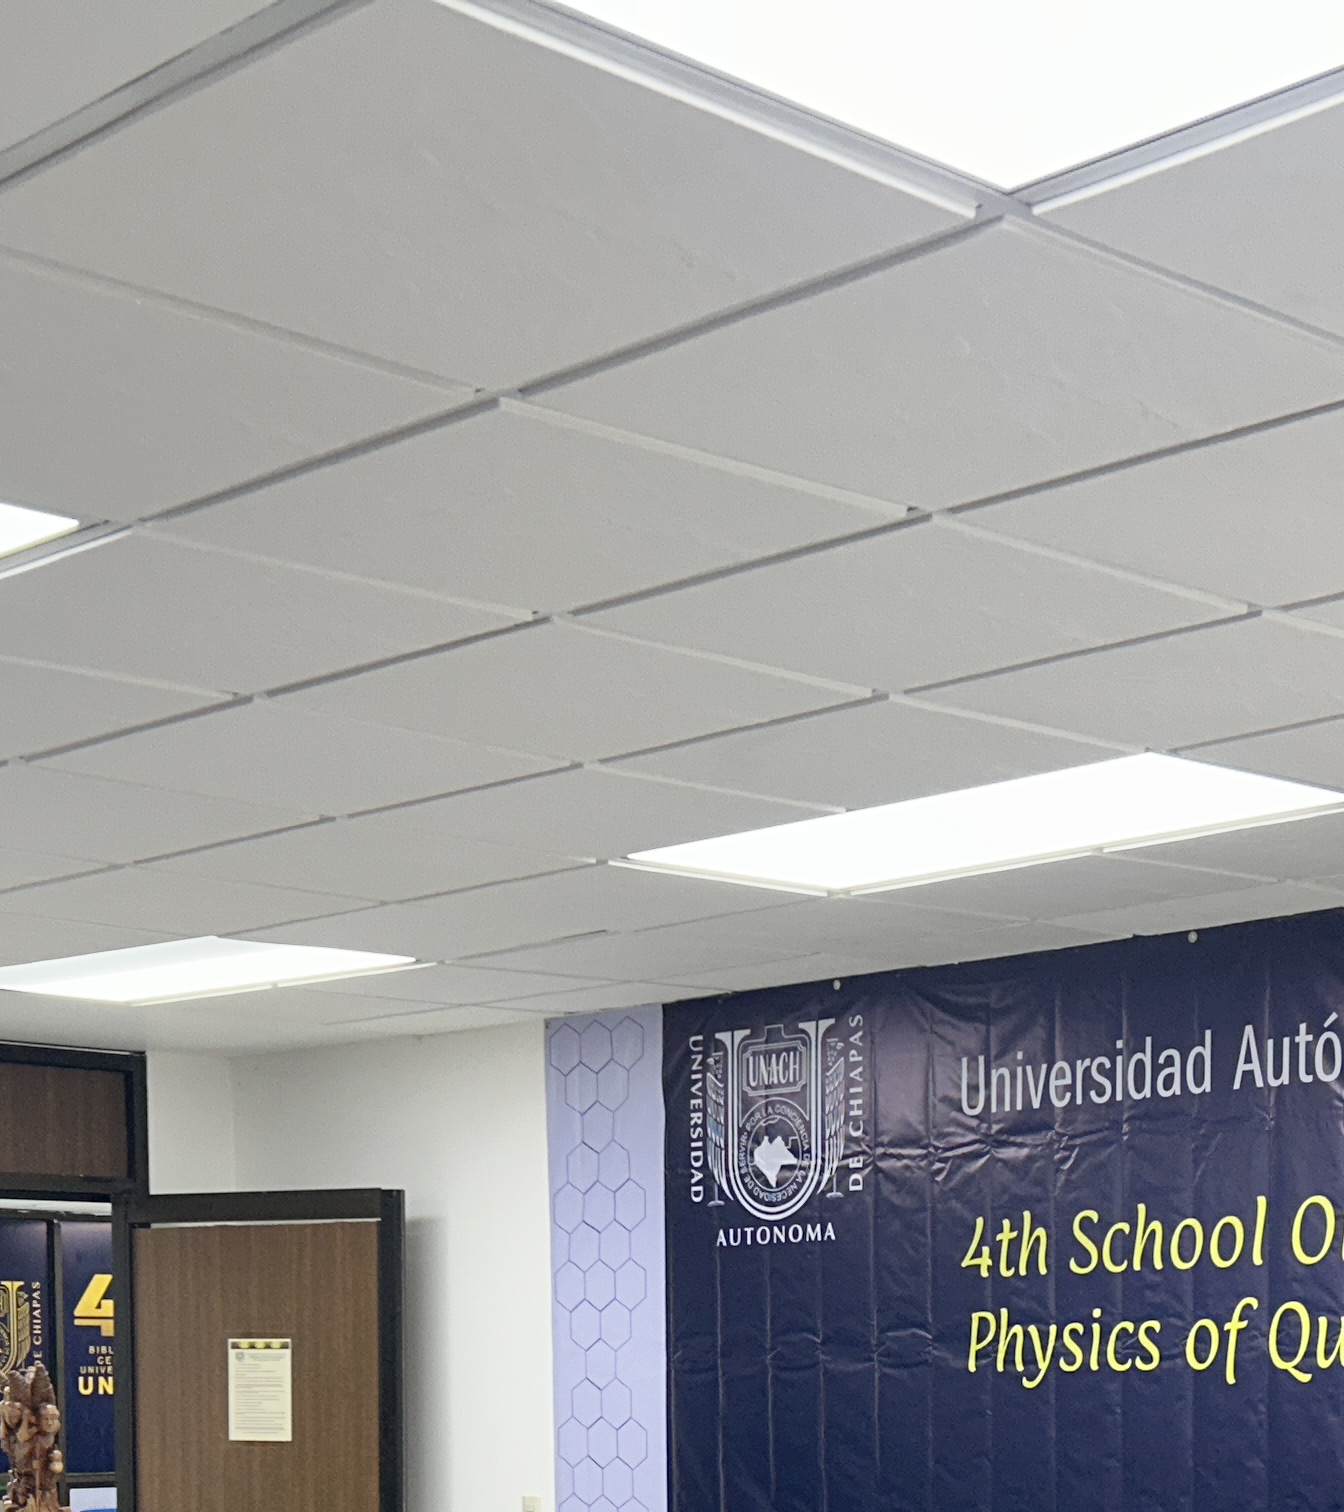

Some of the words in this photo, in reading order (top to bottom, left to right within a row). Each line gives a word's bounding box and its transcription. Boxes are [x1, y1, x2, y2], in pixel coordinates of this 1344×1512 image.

[748, 1051, 800, 1088] UNACH
[848, 1014, 864, 1138] CHIAPAS
[960, 1029, 1212, 1117] Universidad
[688, 1034, 704, 1204] UNIVERSIDAD
[848, 1156, 864, 1192] DE
[715, 1222, 836, 1247] AUTONOMA
[960, 1209, 1049, 1278] 4th
[1068, 1195, 1268, 1275] School
[31, 1281, 43, 1346] CHIAPAS
[966, 1307, 1162, 1389] Physics
[1185, 1296, 1259, 1386] of
